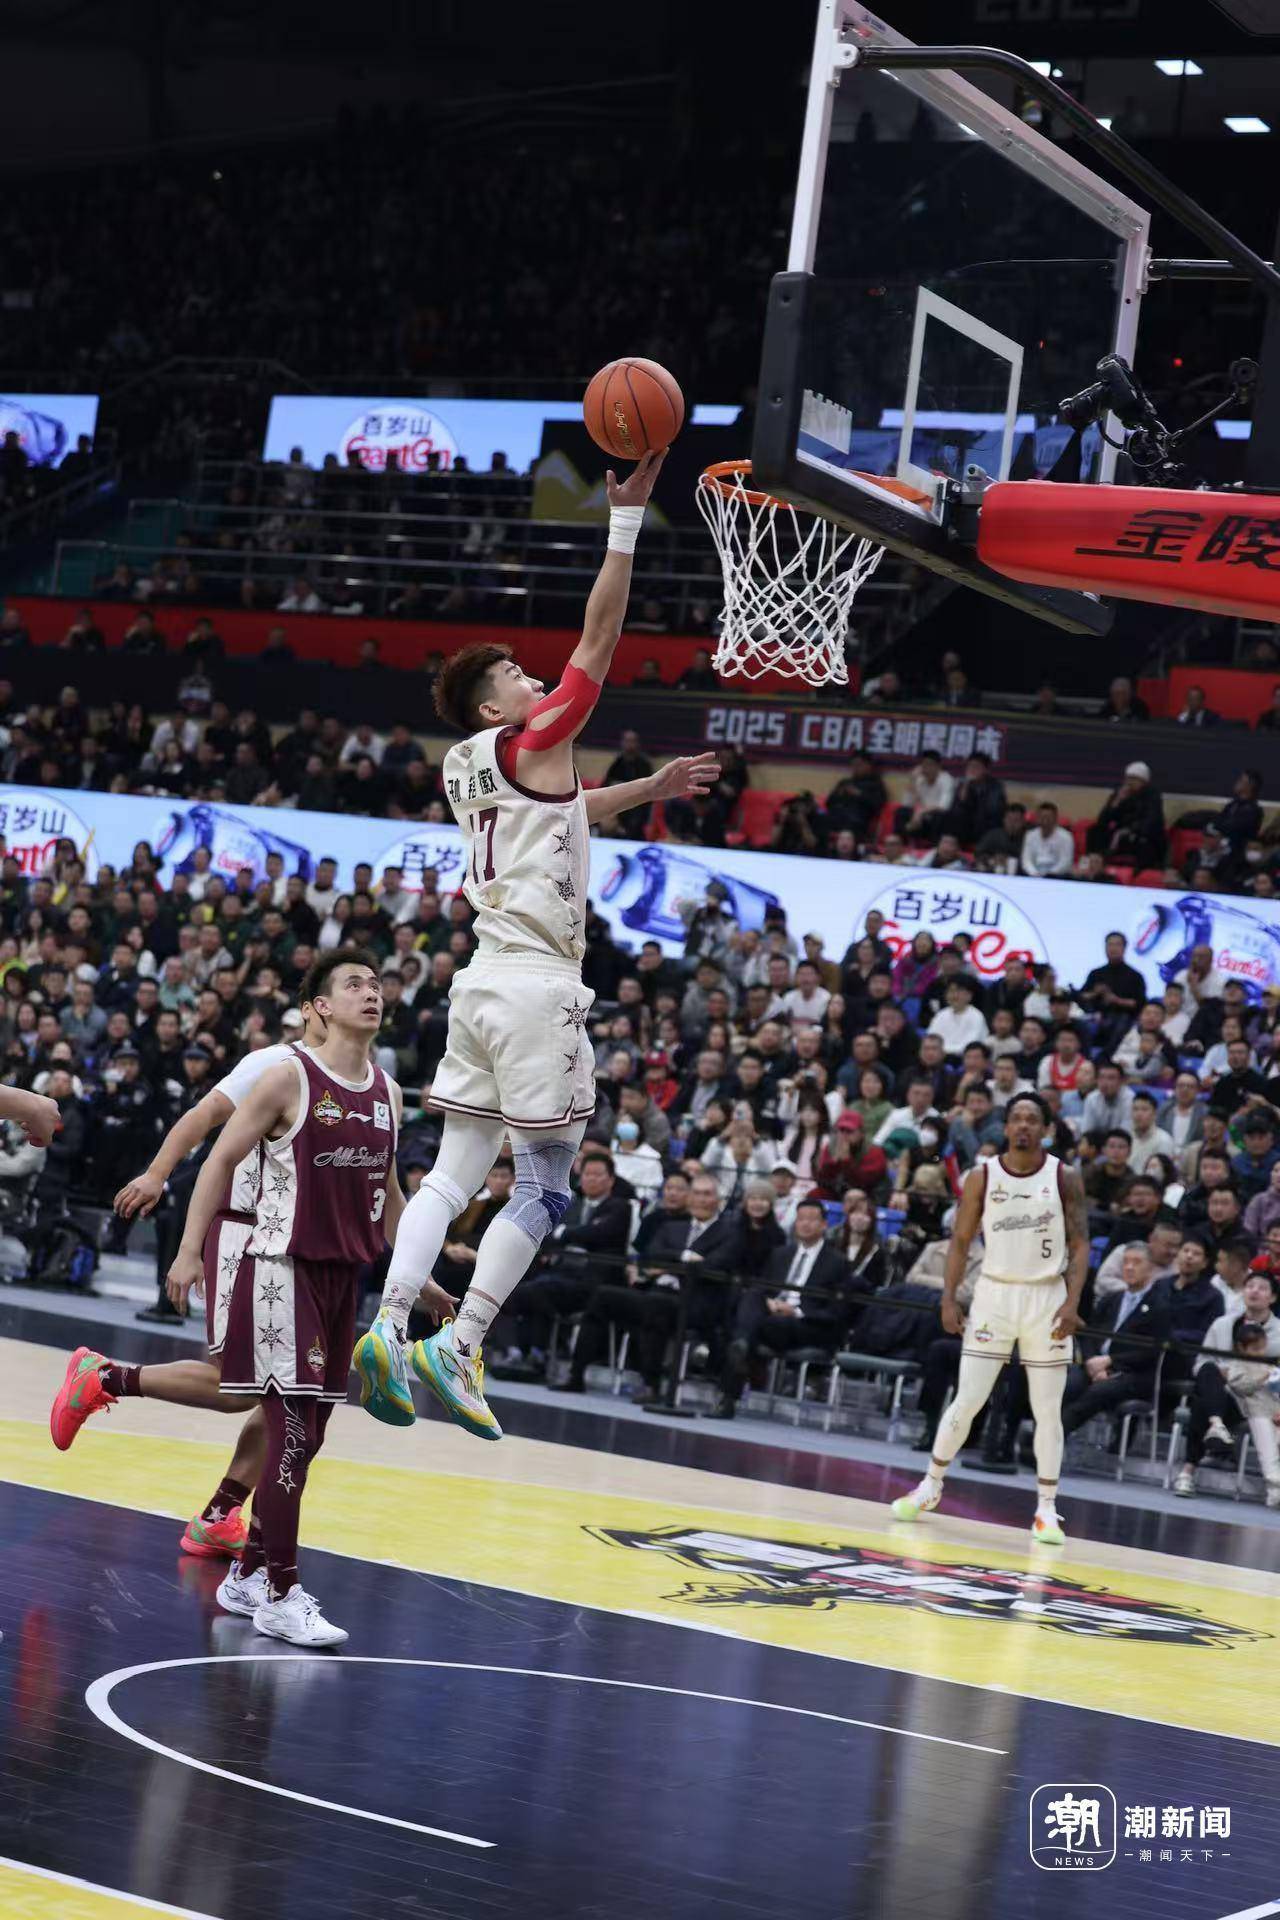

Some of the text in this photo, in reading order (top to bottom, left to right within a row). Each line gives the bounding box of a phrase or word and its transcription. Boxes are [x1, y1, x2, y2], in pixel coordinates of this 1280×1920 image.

[364, 415, 432, 436] 百岁山
[706, 708, 786, 746] 2025
[469, 806, 499, 884] 17
[894, 889, 1002, 926] 百岁山
[370, 1188, 387, 1223] 3
[1041, 1238, 1052, 1259] 5
